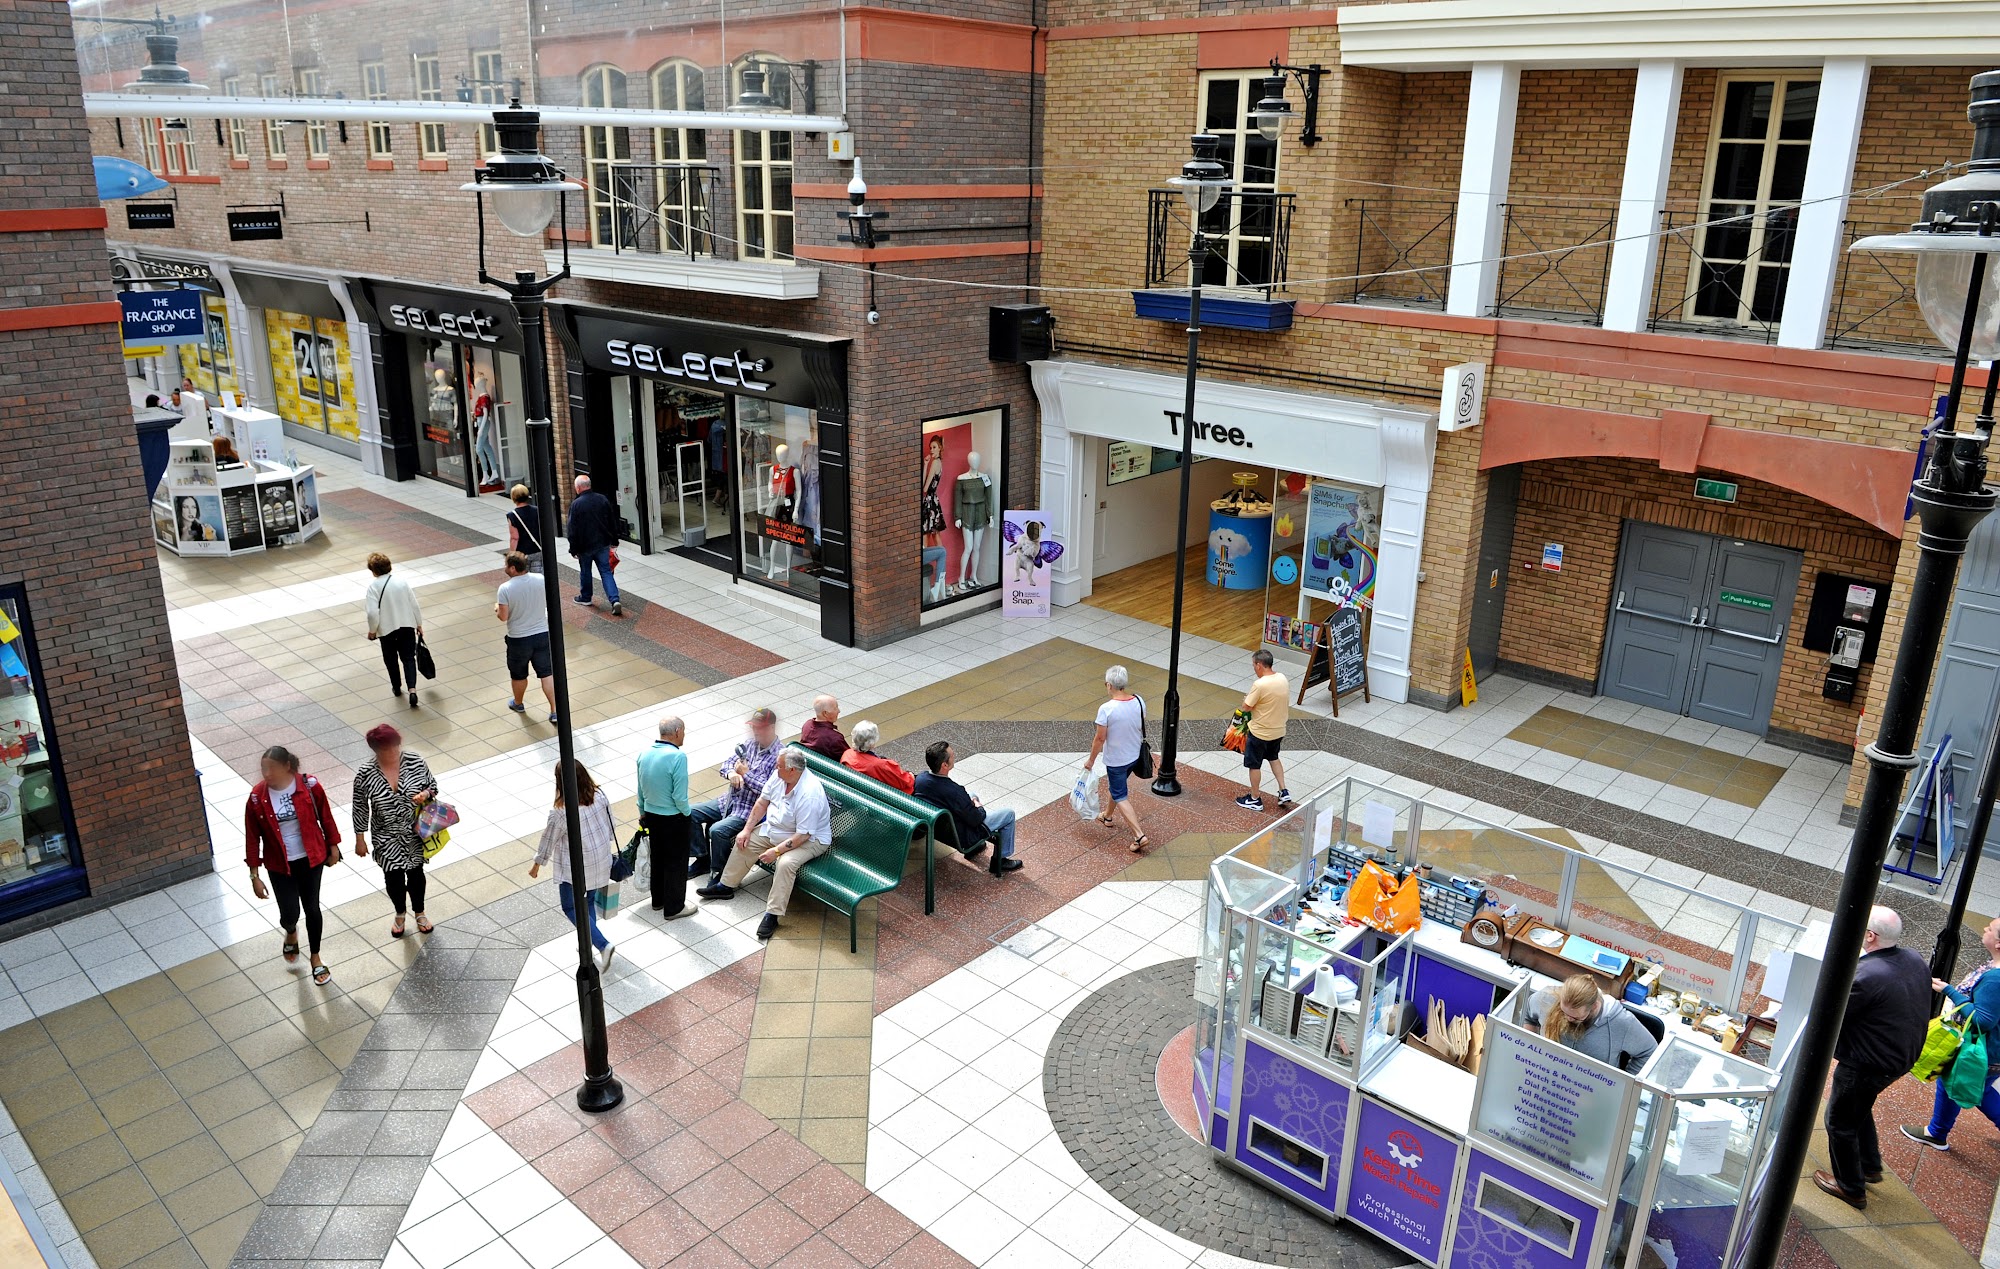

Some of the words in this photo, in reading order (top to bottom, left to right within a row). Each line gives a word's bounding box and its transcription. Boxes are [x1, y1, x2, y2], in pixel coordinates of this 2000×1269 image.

[126, 309, 196, 323] FRAGRANCE
[152, 298, 169, 307] THE
[152, 324, 175, 334] SHOP
[1163, 410, 1253, 448] Three.
[765, 518, 780, 529] BANK
[780, 522, 805, 535] HOLIDAY
[765, 528, 805, 545] SPECTACULAR
[1212, 565, 1237, 575] explore.
[1214, 558, 1235, 568] Come
[1012, 596, 1034, 606] Snap.
[1332, 576, 1352, 597] Oh
[1499, 1031, 1513, 1042] We
[1514, 1037, 1525, 1047] do
[1528, 1044, 1543, 1055] ALL
[1545, 1052, 1573, 1068] repairs
[1575, 1063, 1617, 1087] including:
[1515, 1053, 1550, 1074] Batteries
[1561, 1073, 1594, 1093] Re-seals
[1524, 1068, 1549, 1083] Watch
[1551, 1080, 1580, 1097] Service
[1524, 1079, 1540, 1090] Dial
[1542, 1086, 1576, 1106] Features
[1517, 1086, 1532, 1097] Full
[1534, 1093, 1580, 1118] Restoration
[1521, 1097, 1545, 1112] Watch
[1547, 1109, 1573, 1126] Straps
[1514, 1104, 1538, 1120] Watch
[1540, 1117, 1576, 1138] Bracelets
[1516, 1116, 1538, 1130] Clock
[1540, 1127, 1569, 1145] Repairs
[1510, 1126, 1526, 1136] and
[1527, 1133, 1548, 1147] much
[1550, 1144, 1571, 1156] more
[1363, 1146, 1401, 1175] Keep
[1405, 1168, 1441, 1196] Time
[1505, 1135, 1546, 1161] Accredited
[1548, 1155, 1595, 1181] Watchmaker
[1362, 1161, 1396, 1186] Watch
[1398, 1180, 1439, 1209] Repairs
[1358, 1198, 1389, 1222] Watch
[1393, 1217, 1431, 1245] Repairs
[1365, 1193, 1426, 1232] Professional
